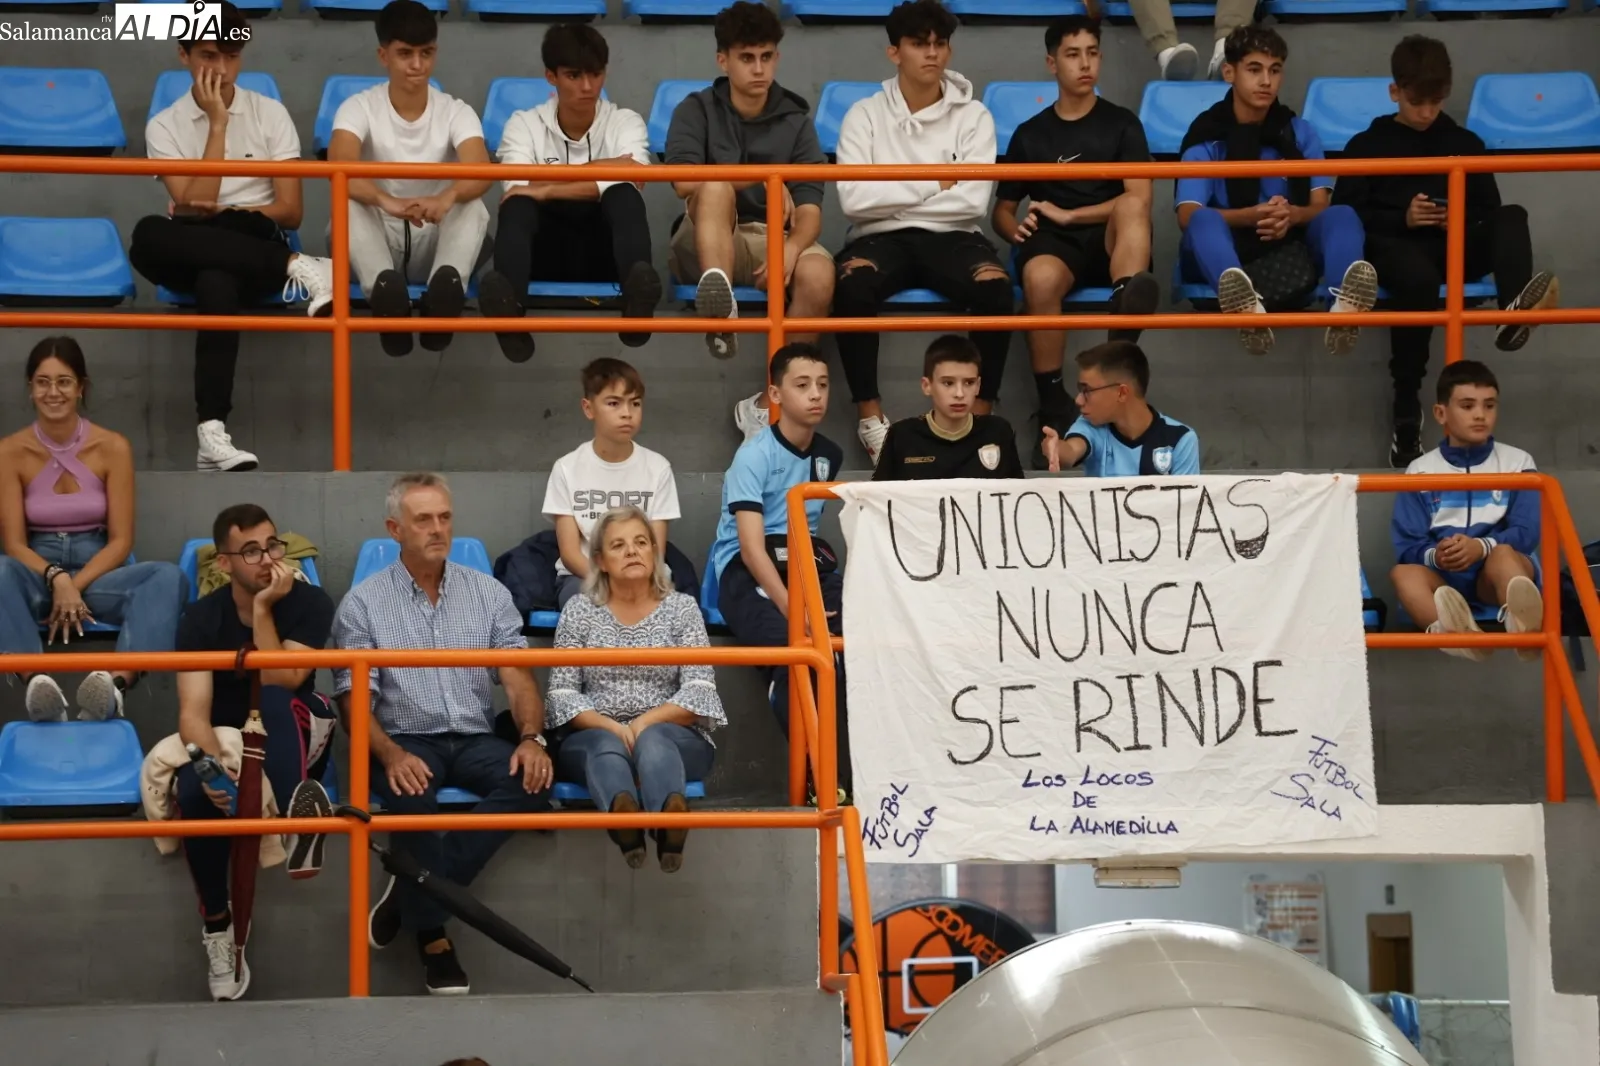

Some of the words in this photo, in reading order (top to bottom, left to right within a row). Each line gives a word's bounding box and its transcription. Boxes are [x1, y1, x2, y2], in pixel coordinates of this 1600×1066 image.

[573, 489, 654, 512] SPORT
[887, 478, 1271, 582] UNIONISTAS
[995, 581, 1224, 663] NUNCA
[946, 684, 1042, 766] SE
[1073, 659, 1298, 753] RINDE
[1079, 765, 1154, 787] LOCOS
[1072, 791, 1098, 808] DE
[893, 806, 938, 858] SALA
[1029, 815, 1059, 836] LA
